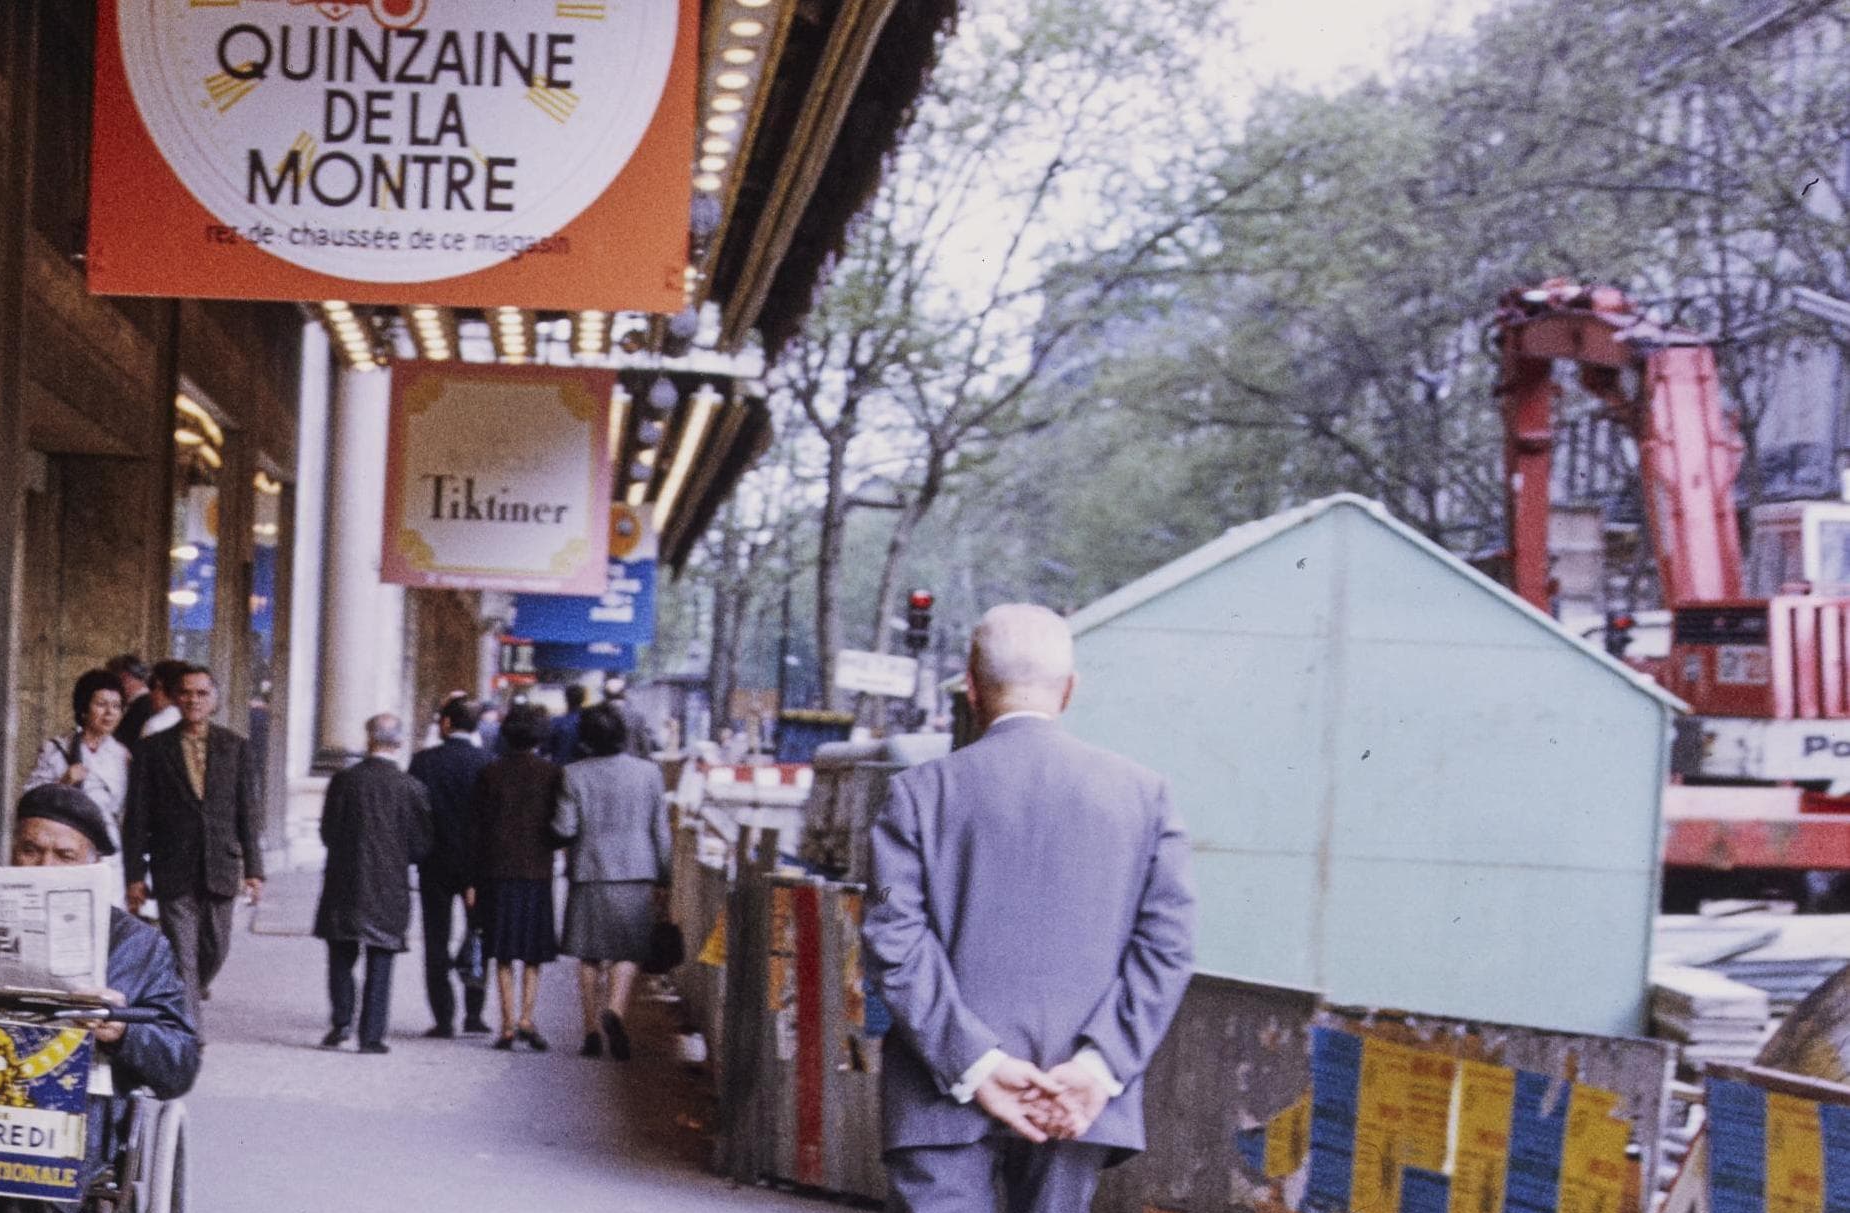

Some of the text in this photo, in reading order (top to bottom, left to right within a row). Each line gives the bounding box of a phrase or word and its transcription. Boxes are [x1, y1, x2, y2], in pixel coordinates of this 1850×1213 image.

[217, 23, 576, 90] QUINZAINE
[324, 90, 468, 148] DE LA
[248, 149, 516, 212] MONTRE
[420, 473, 568, 523] Tiktiner
